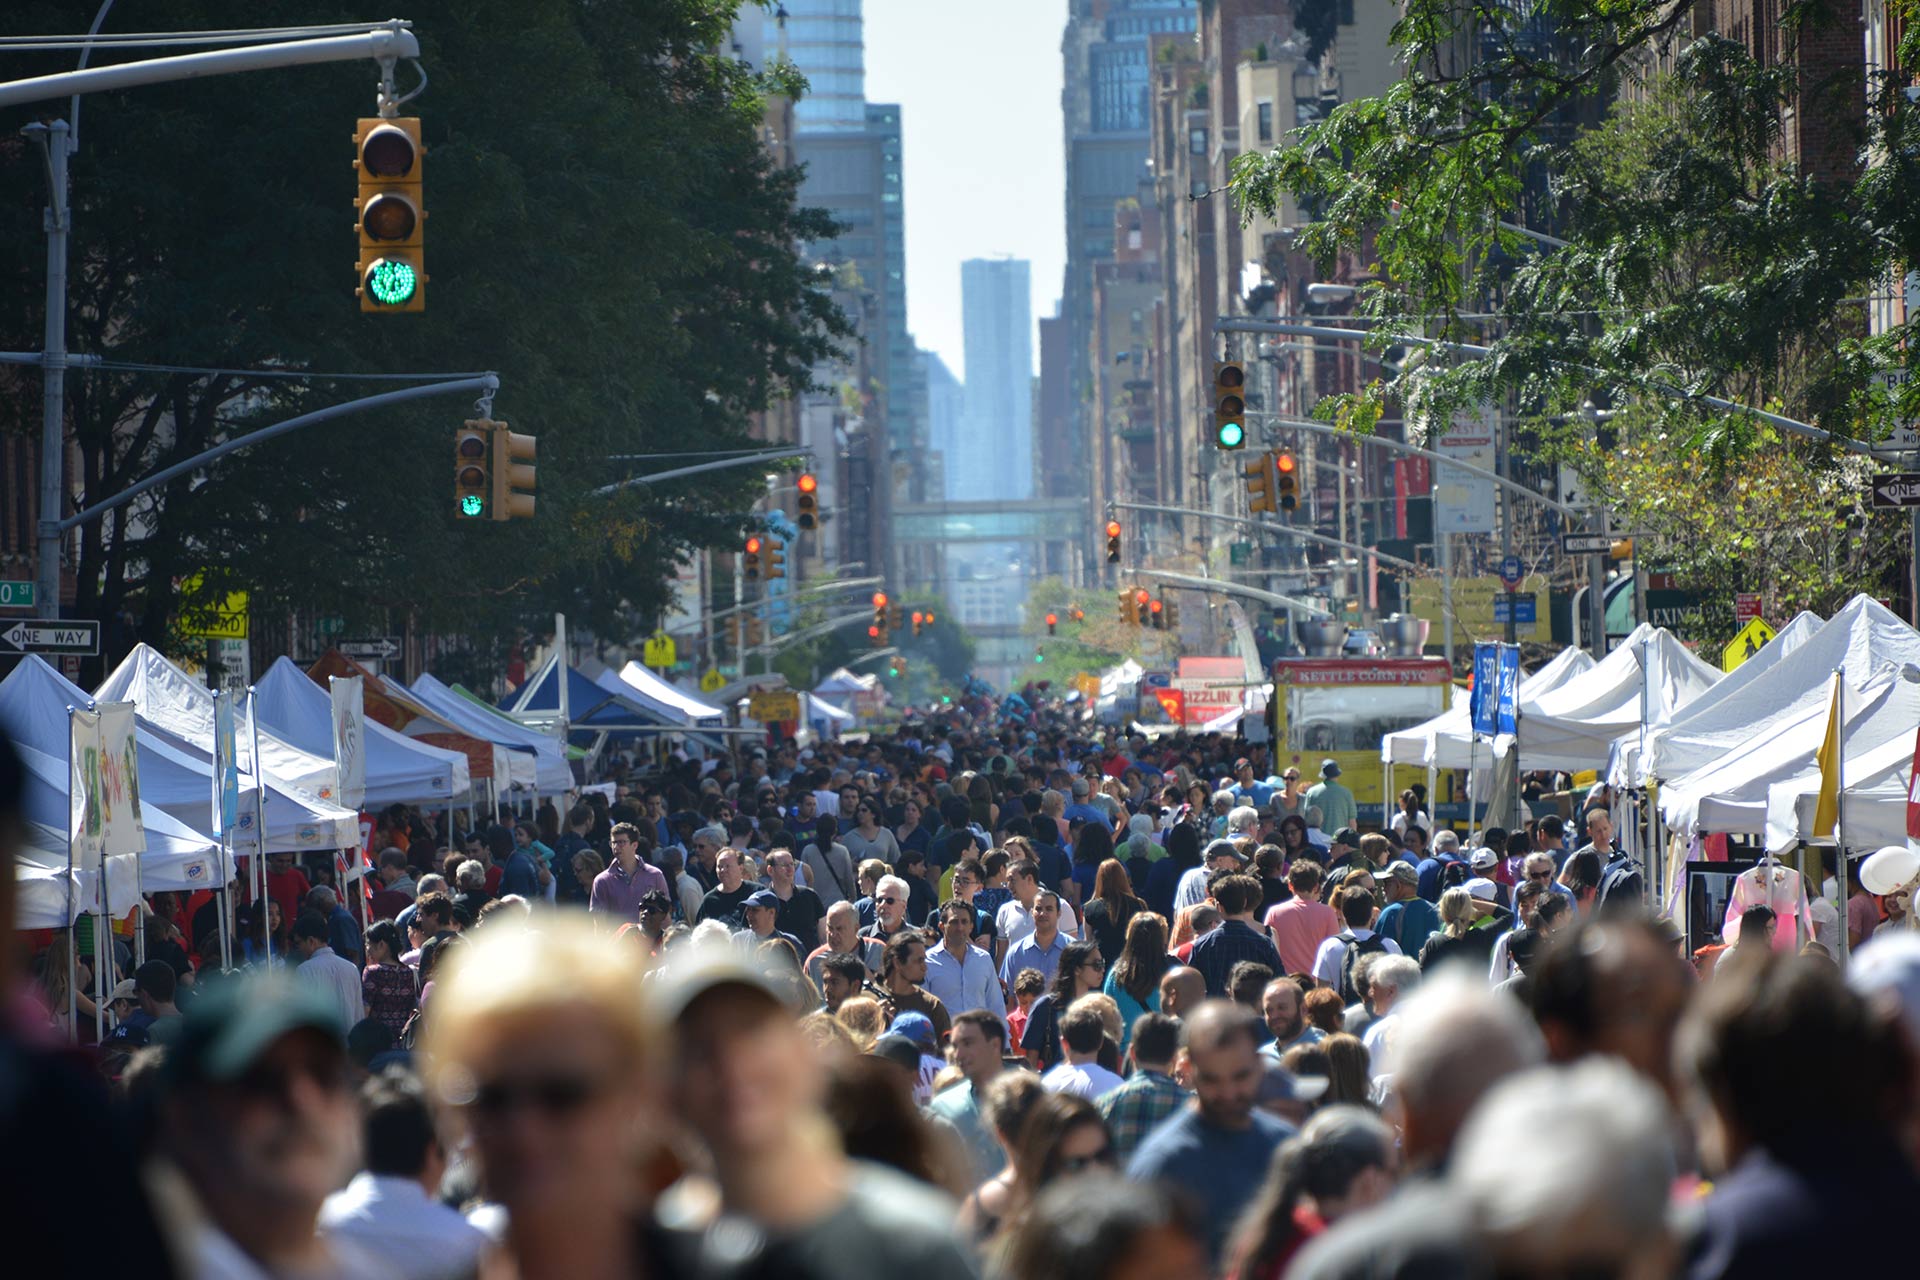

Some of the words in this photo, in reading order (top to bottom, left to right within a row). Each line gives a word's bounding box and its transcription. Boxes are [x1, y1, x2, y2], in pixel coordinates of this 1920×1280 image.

[1888, 484, 1917, 496] ONE
[20, 584, 30, 595] ST
[12, 630, 40, 643] ONE
[54, 631, 85, 643] WAY
[1300, 671, 1355, 681] KETTLE
[1359, 671, 1396, 681] CORN
